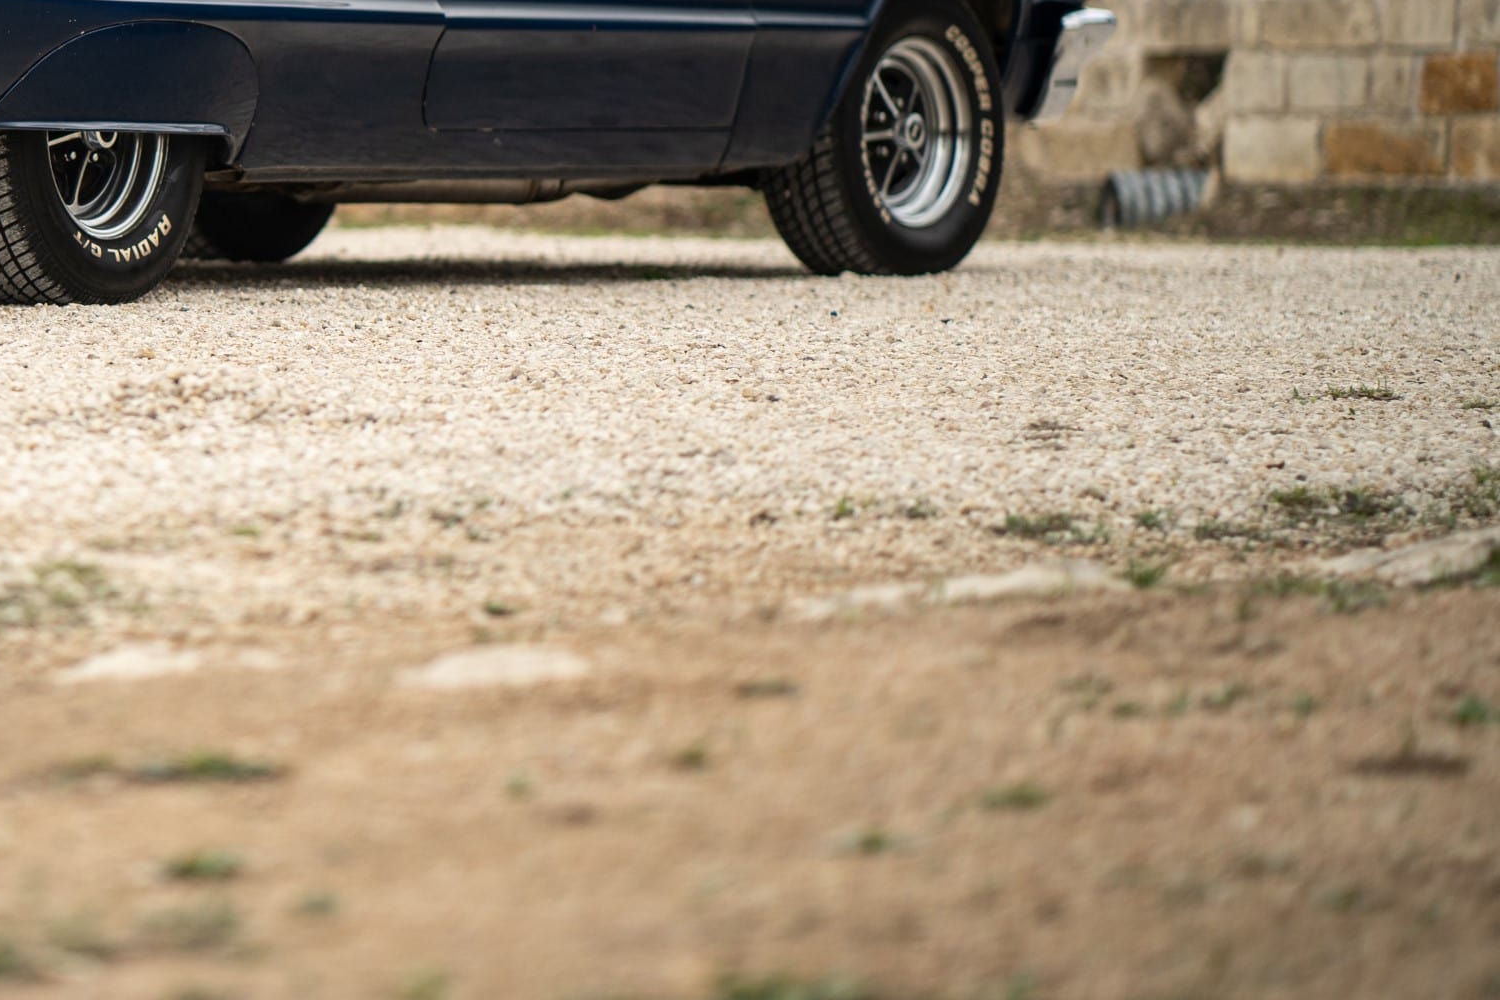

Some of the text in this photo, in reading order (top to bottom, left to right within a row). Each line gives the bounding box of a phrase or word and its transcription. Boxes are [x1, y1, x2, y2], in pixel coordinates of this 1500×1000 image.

[945, 24, 992, 111] COOPER
[73, 213, 173, 263] RADIAL G/T
